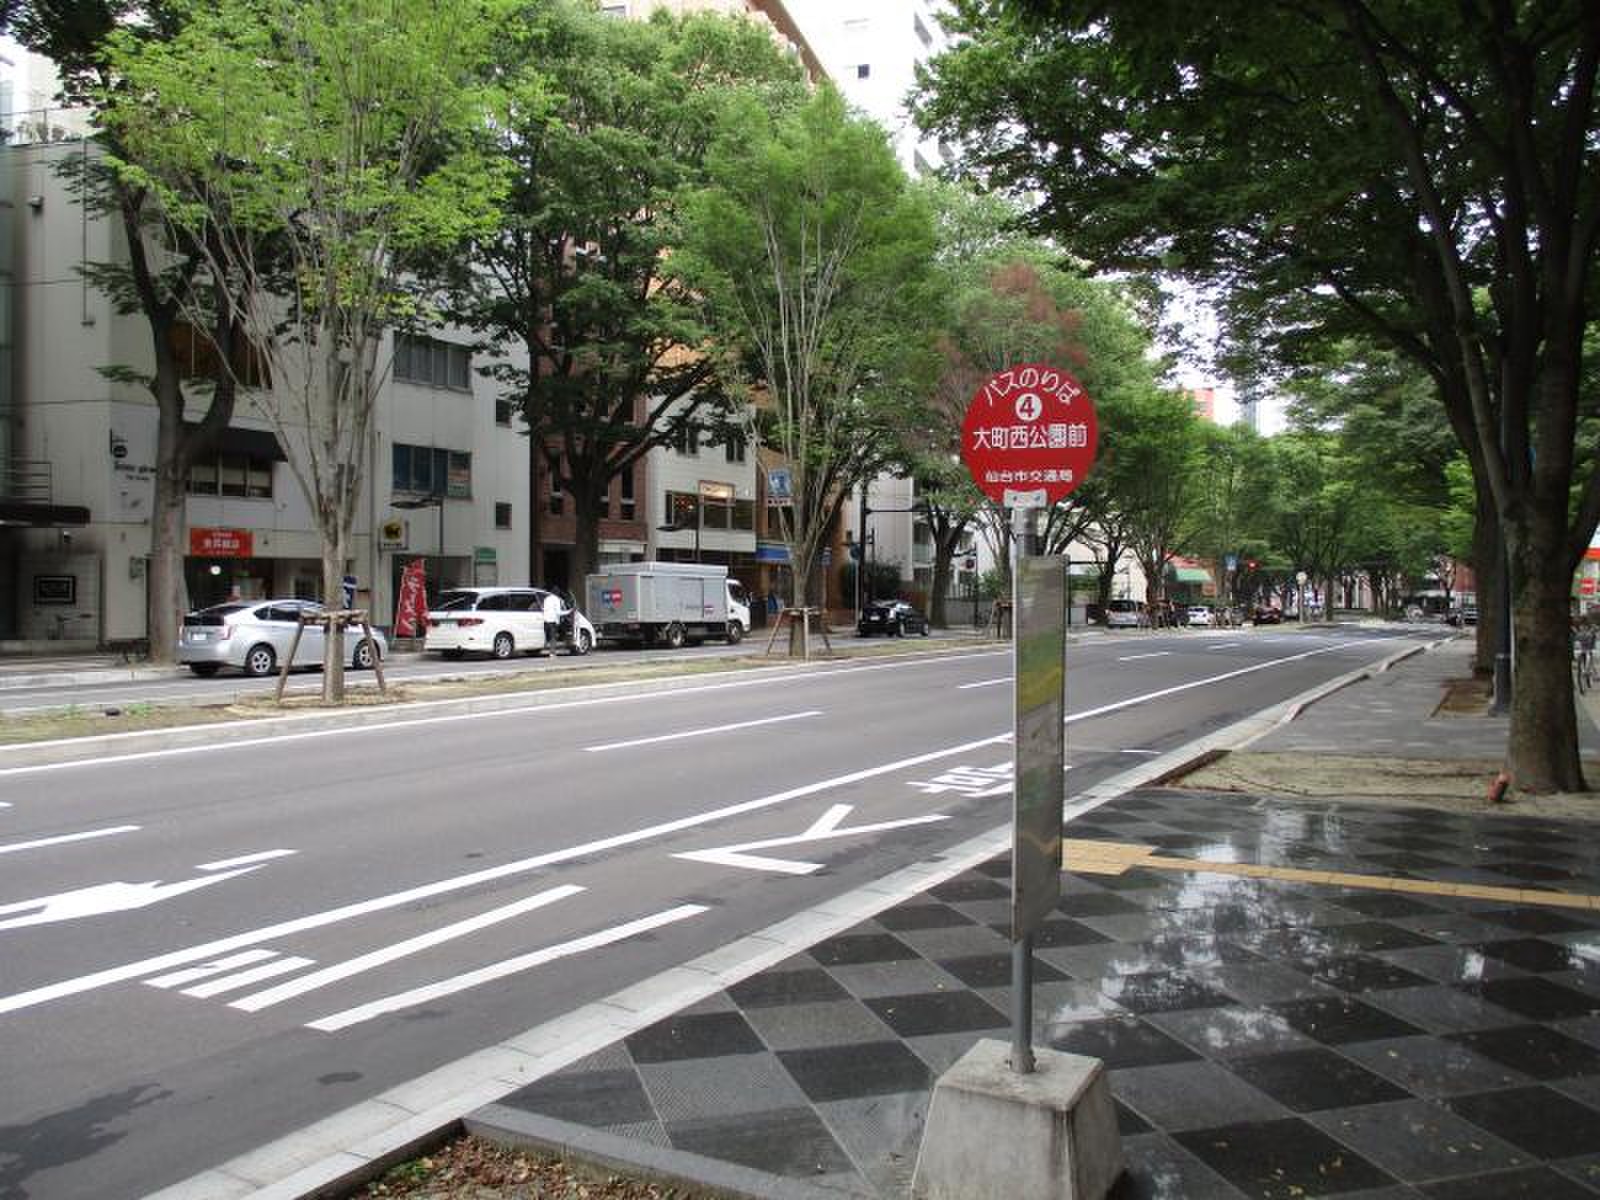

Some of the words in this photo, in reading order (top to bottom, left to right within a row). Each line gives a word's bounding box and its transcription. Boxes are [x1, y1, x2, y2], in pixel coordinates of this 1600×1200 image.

[983, 368, 1082, 407] バスのりば
[1018, 395, 1038, 419] 4
[973, 422, 1087, 450] 大町西公園前
[985, 469, 1073, 483] 仙台市交通局
